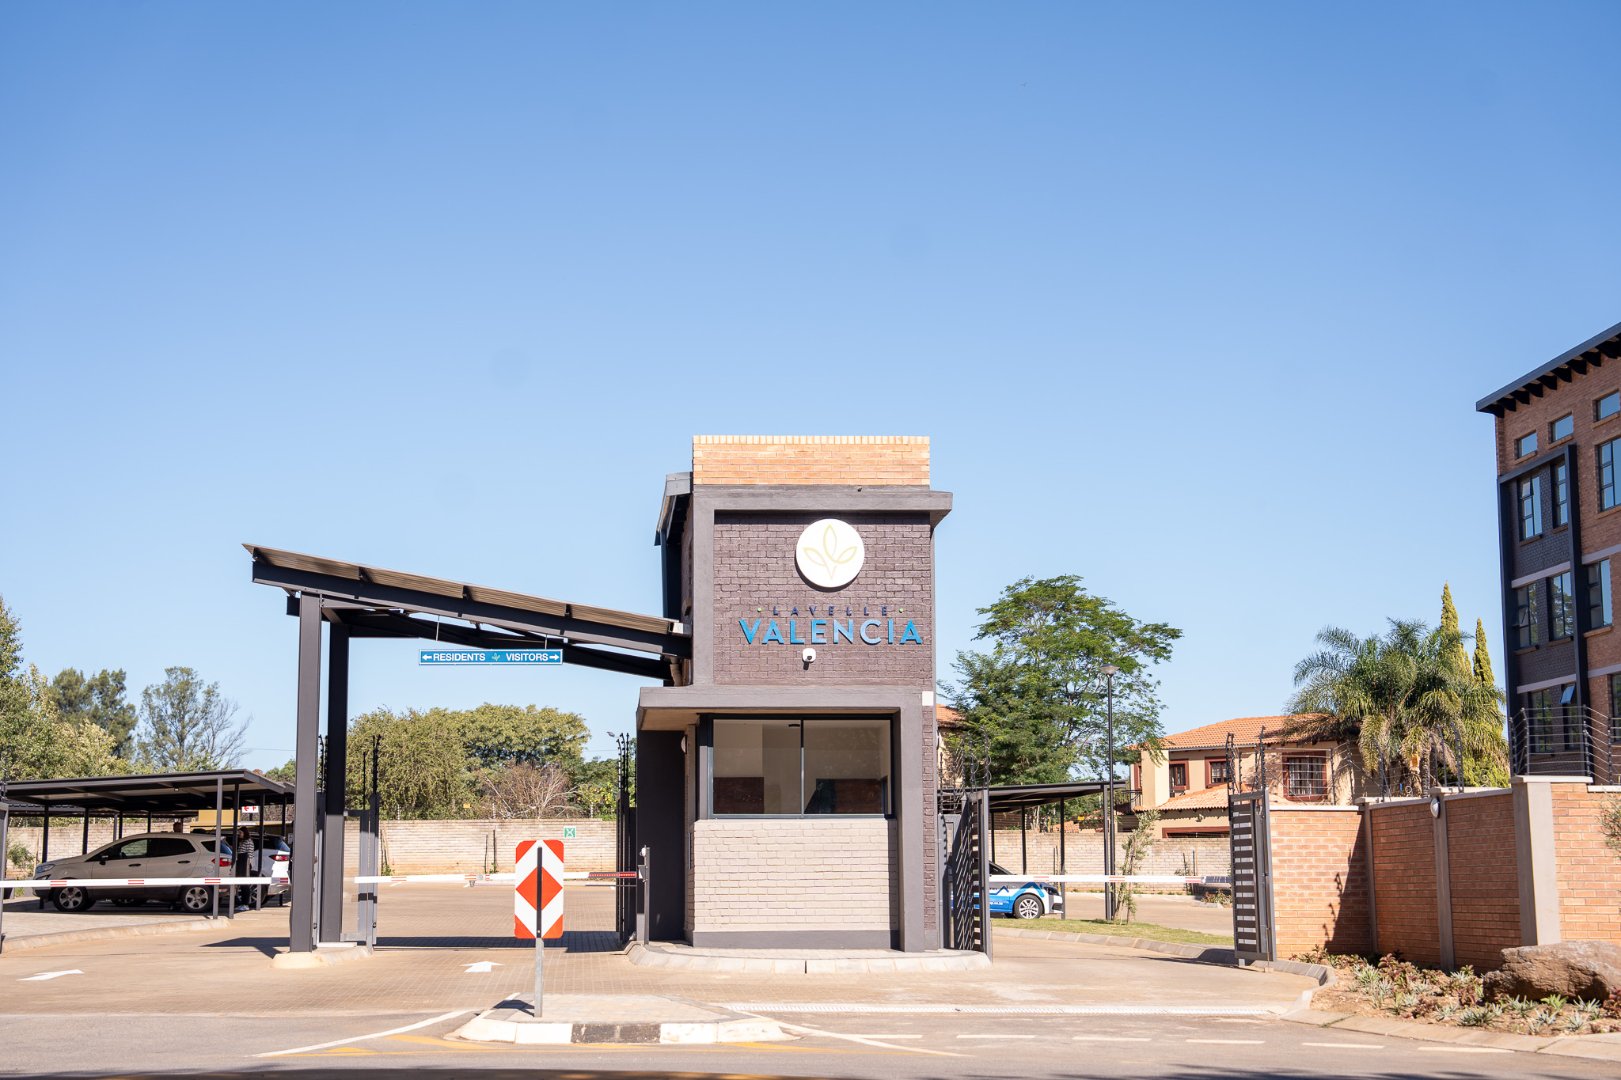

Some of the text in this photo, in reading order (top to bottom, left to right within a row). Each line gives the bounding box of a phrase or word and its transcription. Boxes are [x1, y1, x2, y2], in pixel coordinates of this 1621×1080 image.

[772, 606, 888, 616] LAVELLE
[738, 619, 923, 645] VALENCIA
[433, 653, 549, 661] RESIDENTS VISITORS
